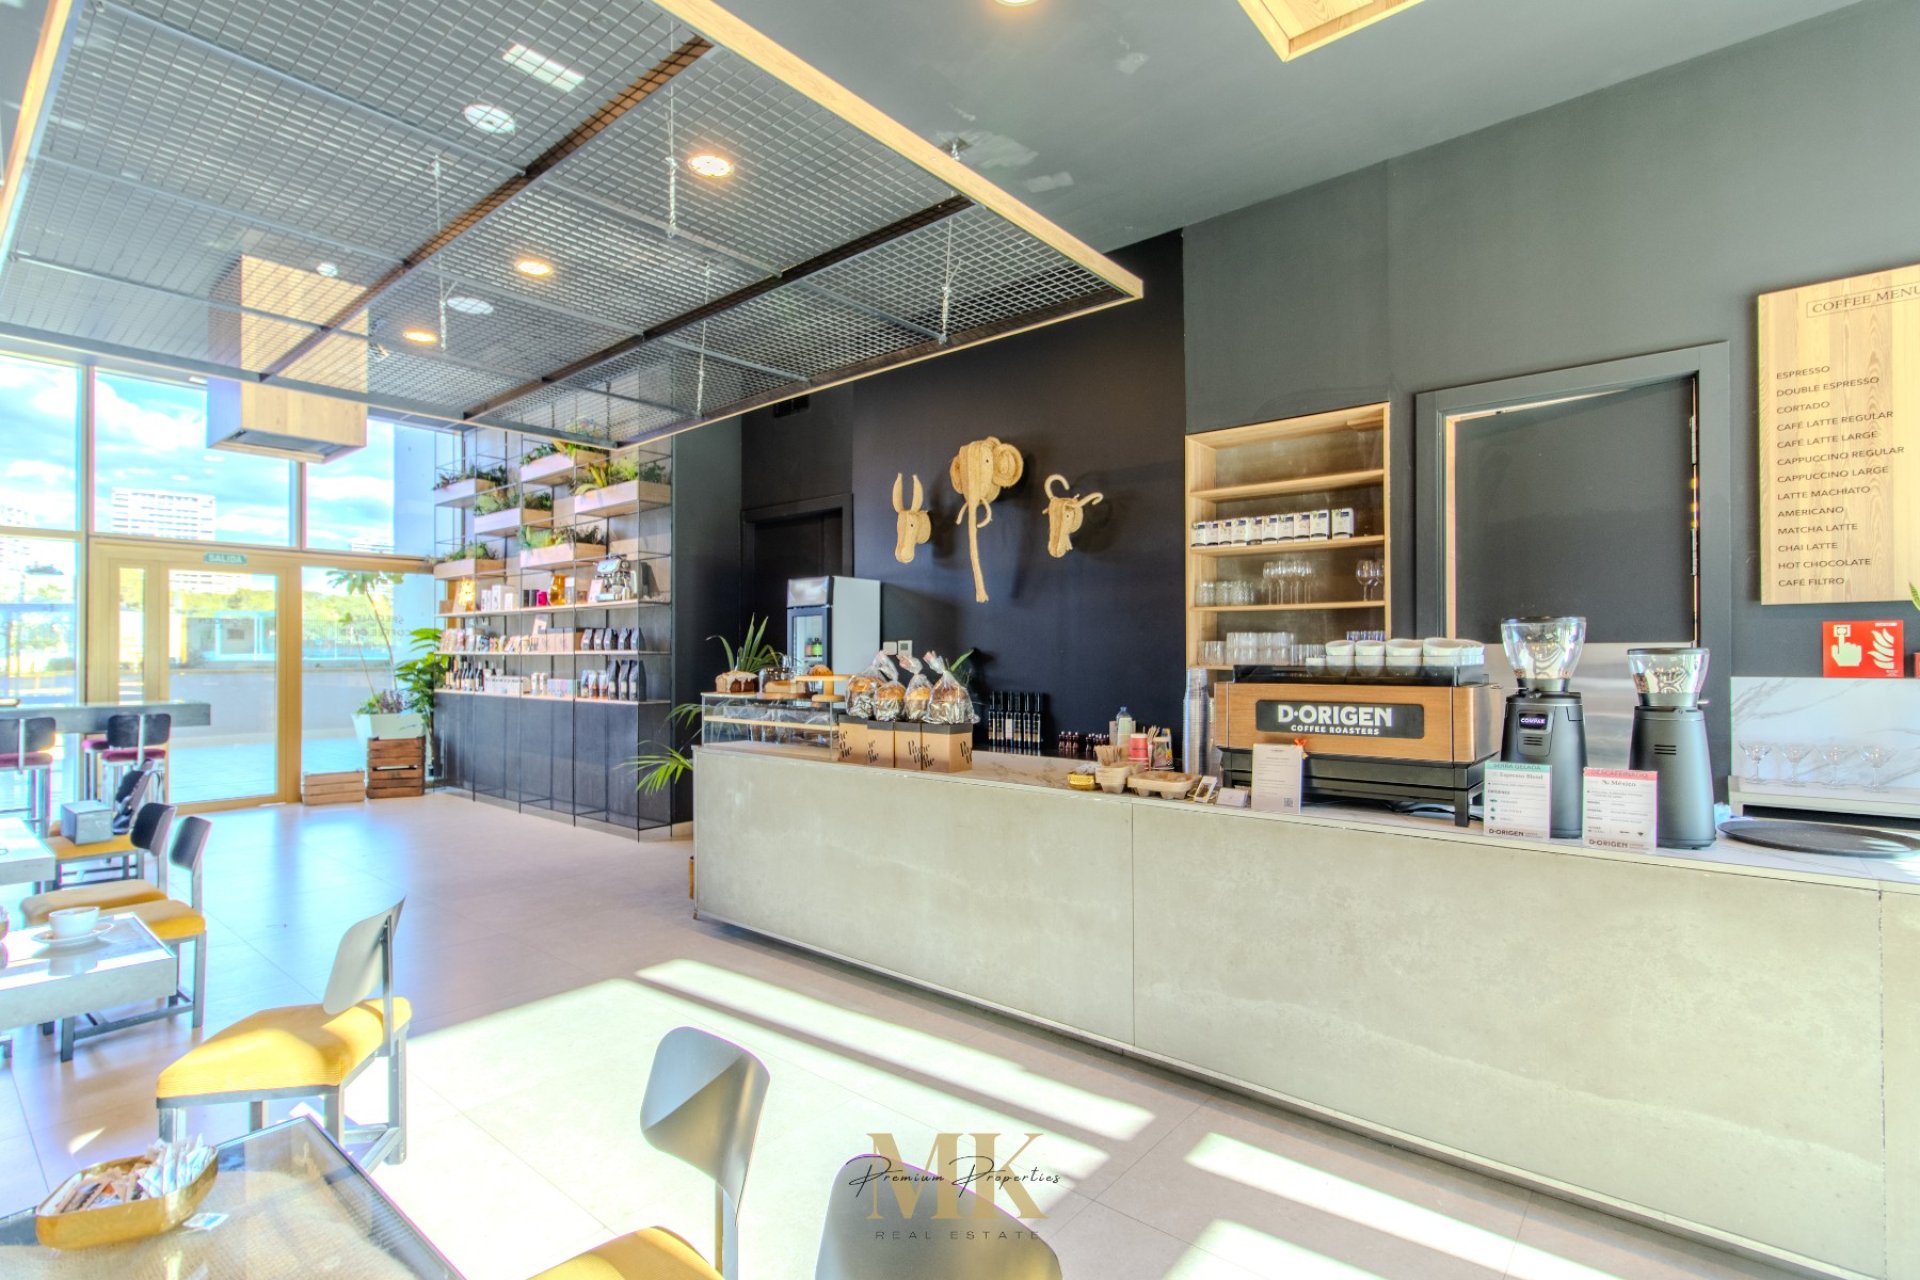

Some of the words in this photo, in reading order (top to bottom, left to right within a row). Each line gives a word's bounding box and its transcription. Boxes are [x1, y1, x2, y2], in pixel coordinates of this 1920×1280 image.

[1812, 295, 1871, 313] COFFEE
[1776, 365, 1830, 379] ESPRESSO
[1776, 384, 1820, 397] DOUBLE
[1823, 376, 1880, 390] ESPRESSO
[1776, 401, 1830, 414] CORTADO
[1807, 417, 1838, 428] LATTE
[1841, 411, 1894, 423] REGULAR
[1807, 435, 1838, 445] LATTE
[1841, 431, 1878, 441] LARGE
[1777, 452, 1849, 466] CAPPUCCINO
[1851, 446, 1905, 458] REGULAR
[1777, 469, 1849, 483] CAPPUCCINO
[1852, 466, 1888, 477] LARGE
[1777, 492, 1808, 501] LATTE
[1810, 485, 1871, 497] MACHIATO
[1777, 506, 1844, 517] AMERICANO
[1777, 525, 1823, 534] MATCHA
[1825, 523, 1858, 532] LATTE
[1807, 543, 1838, 551] LATTE
[1803, 558, 1872, 569] CHOCOLATE
[1808, 577, 1845, 586] FILTRO
[1290, 724, 1326, 733] COFFEE
[1329, 726, 1380, 735] ROASTERS
